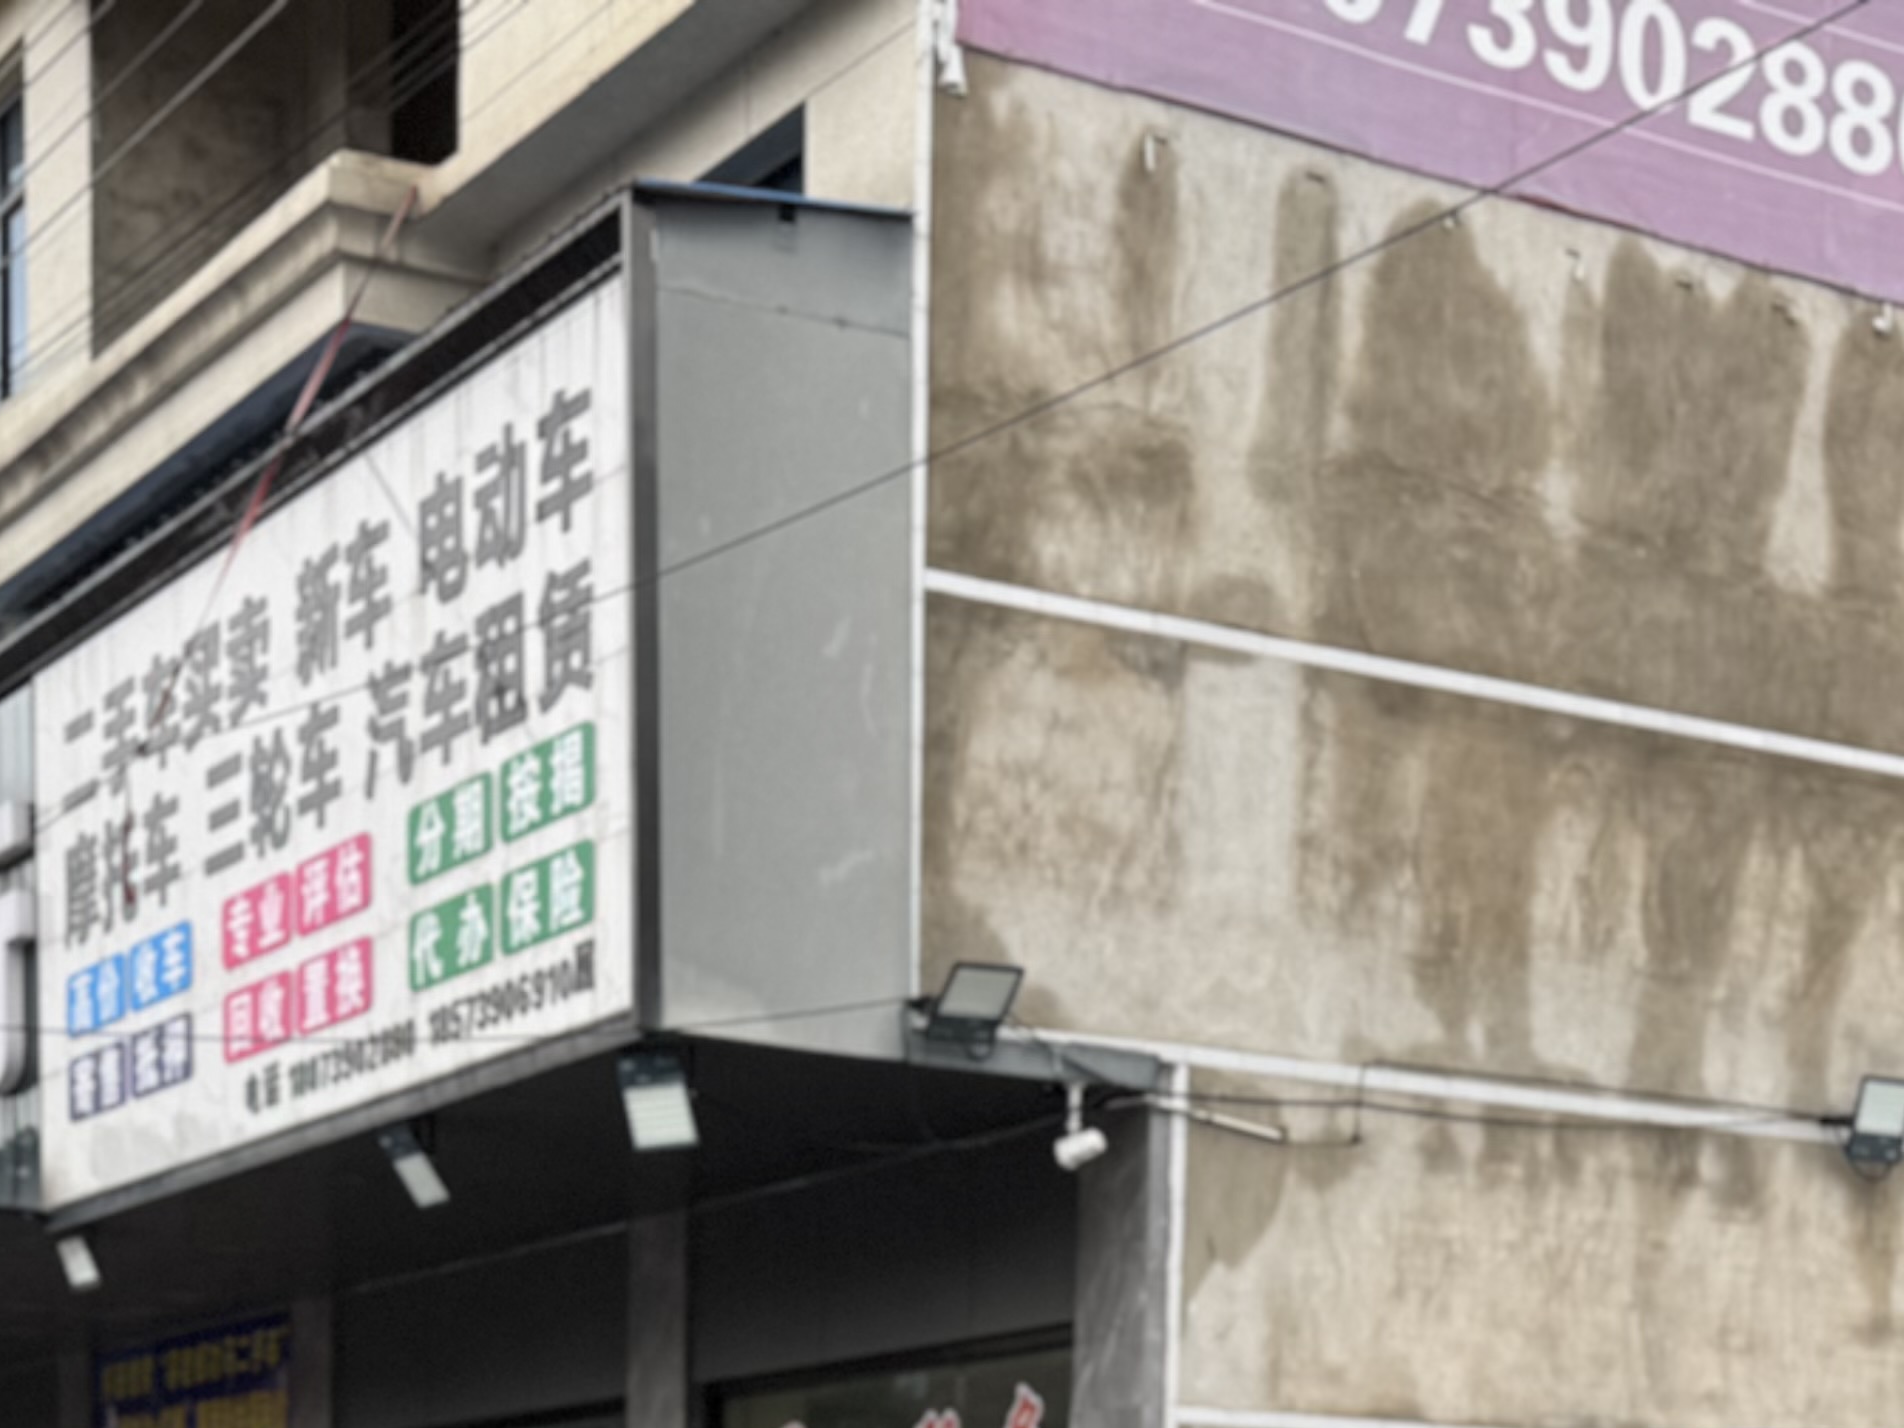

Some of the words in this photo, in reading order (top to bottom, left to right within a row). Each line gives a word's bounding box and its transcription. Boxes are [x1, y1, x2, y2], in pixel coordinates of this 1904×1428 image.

[64, 596, 270, 812] 二手车买卖
[295, 519, 391, 687] 新车
[419, 387, 593, 604] 电动车
[64, 793, 180, 950] 摩托车
[202, 702, 342, 876] 三轮车
[365, 557, 593, 800] 汽车租赁
[413, 842, 584, 982] 代办保险
